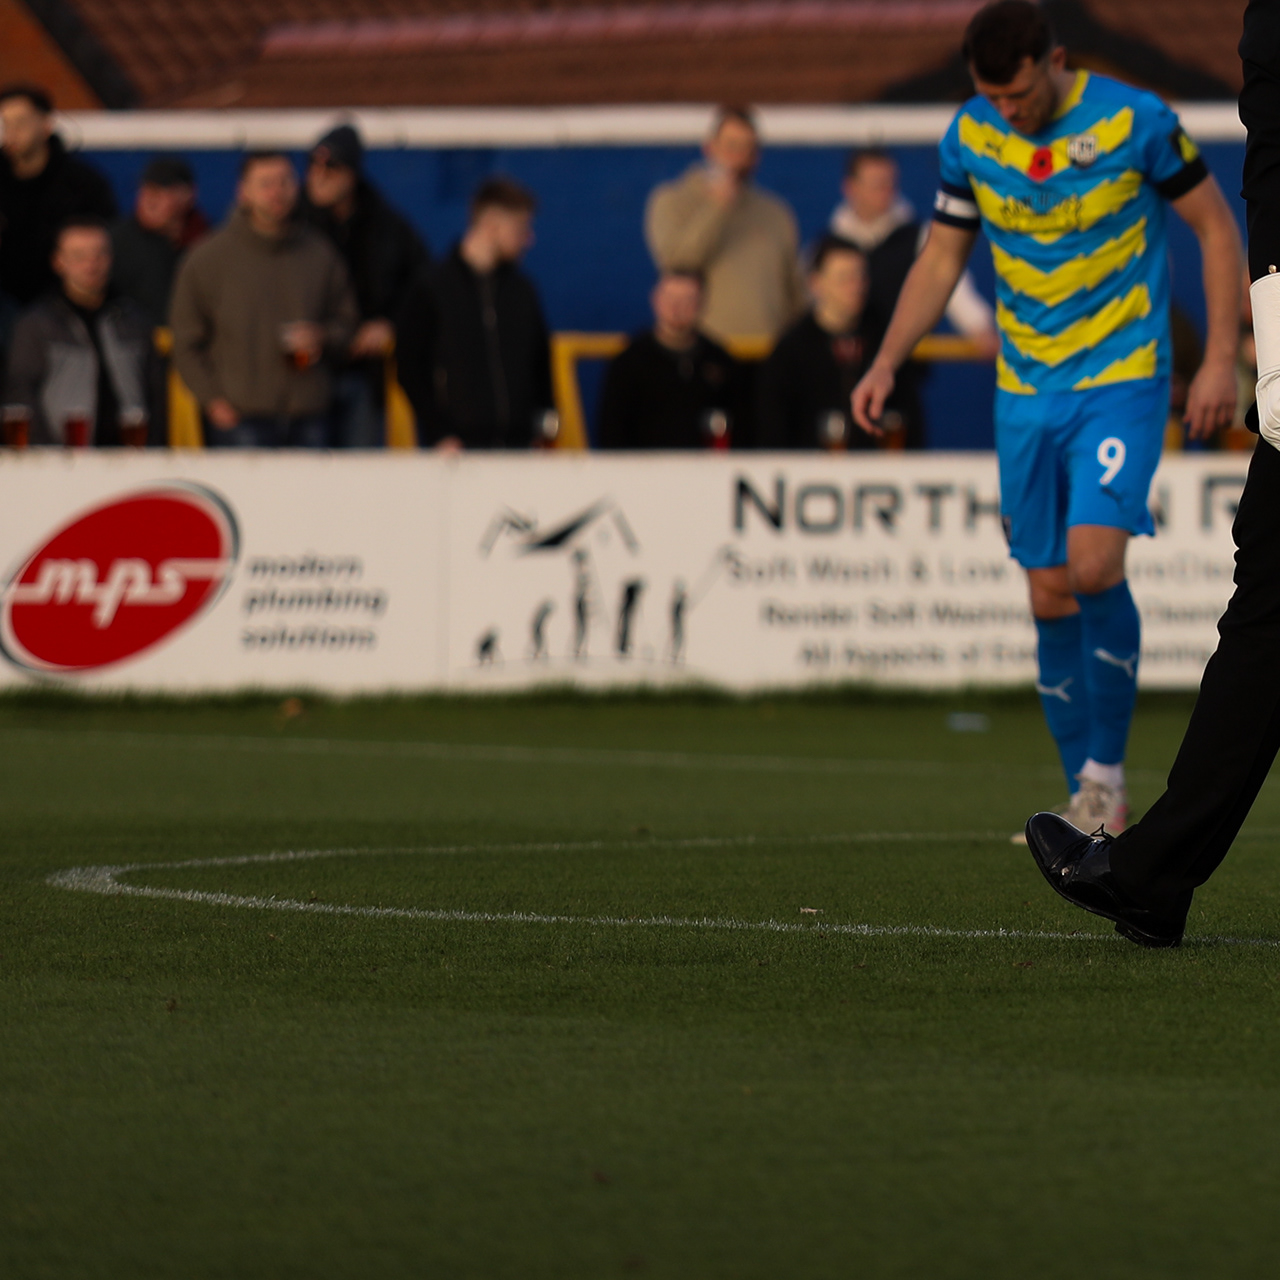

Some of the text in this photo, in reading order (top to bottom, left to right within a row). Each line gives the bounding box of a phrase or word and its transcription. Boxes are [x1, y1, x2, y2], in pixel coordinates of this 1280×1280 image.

[1097, 436, 1126, 485] 9
[734, 474, 1170, 536] NORTH
[246, 551, 364, 582] modern
[12, 557, 228, 629] mps
[243, 585, 389, 618] plumbing
[240, 622, 377, 652] solutions
